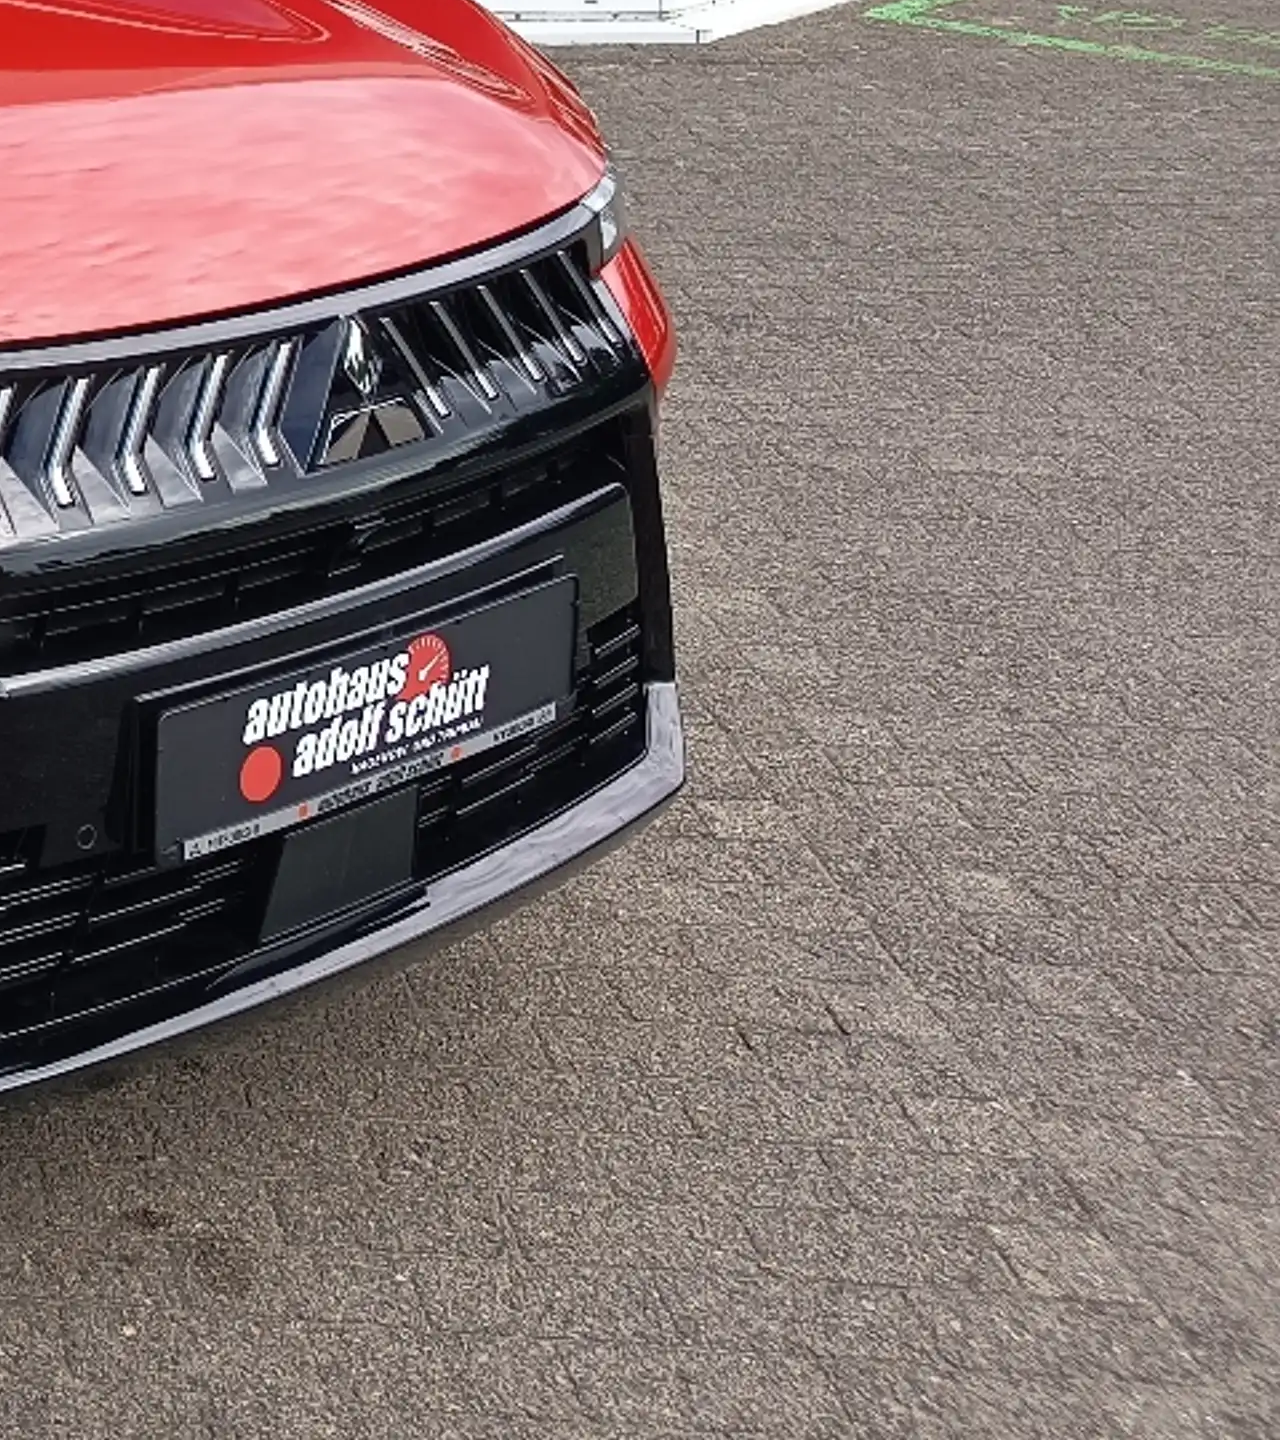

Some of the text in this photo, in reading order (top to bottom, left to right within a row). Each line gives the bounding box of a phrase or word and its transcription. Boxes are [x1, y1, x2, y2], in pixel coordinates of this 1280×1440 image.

[241, 651, 411, 746] autohaus
[291, 698, 387, 779] adolf
[384, 663, 490, 744] schütt
